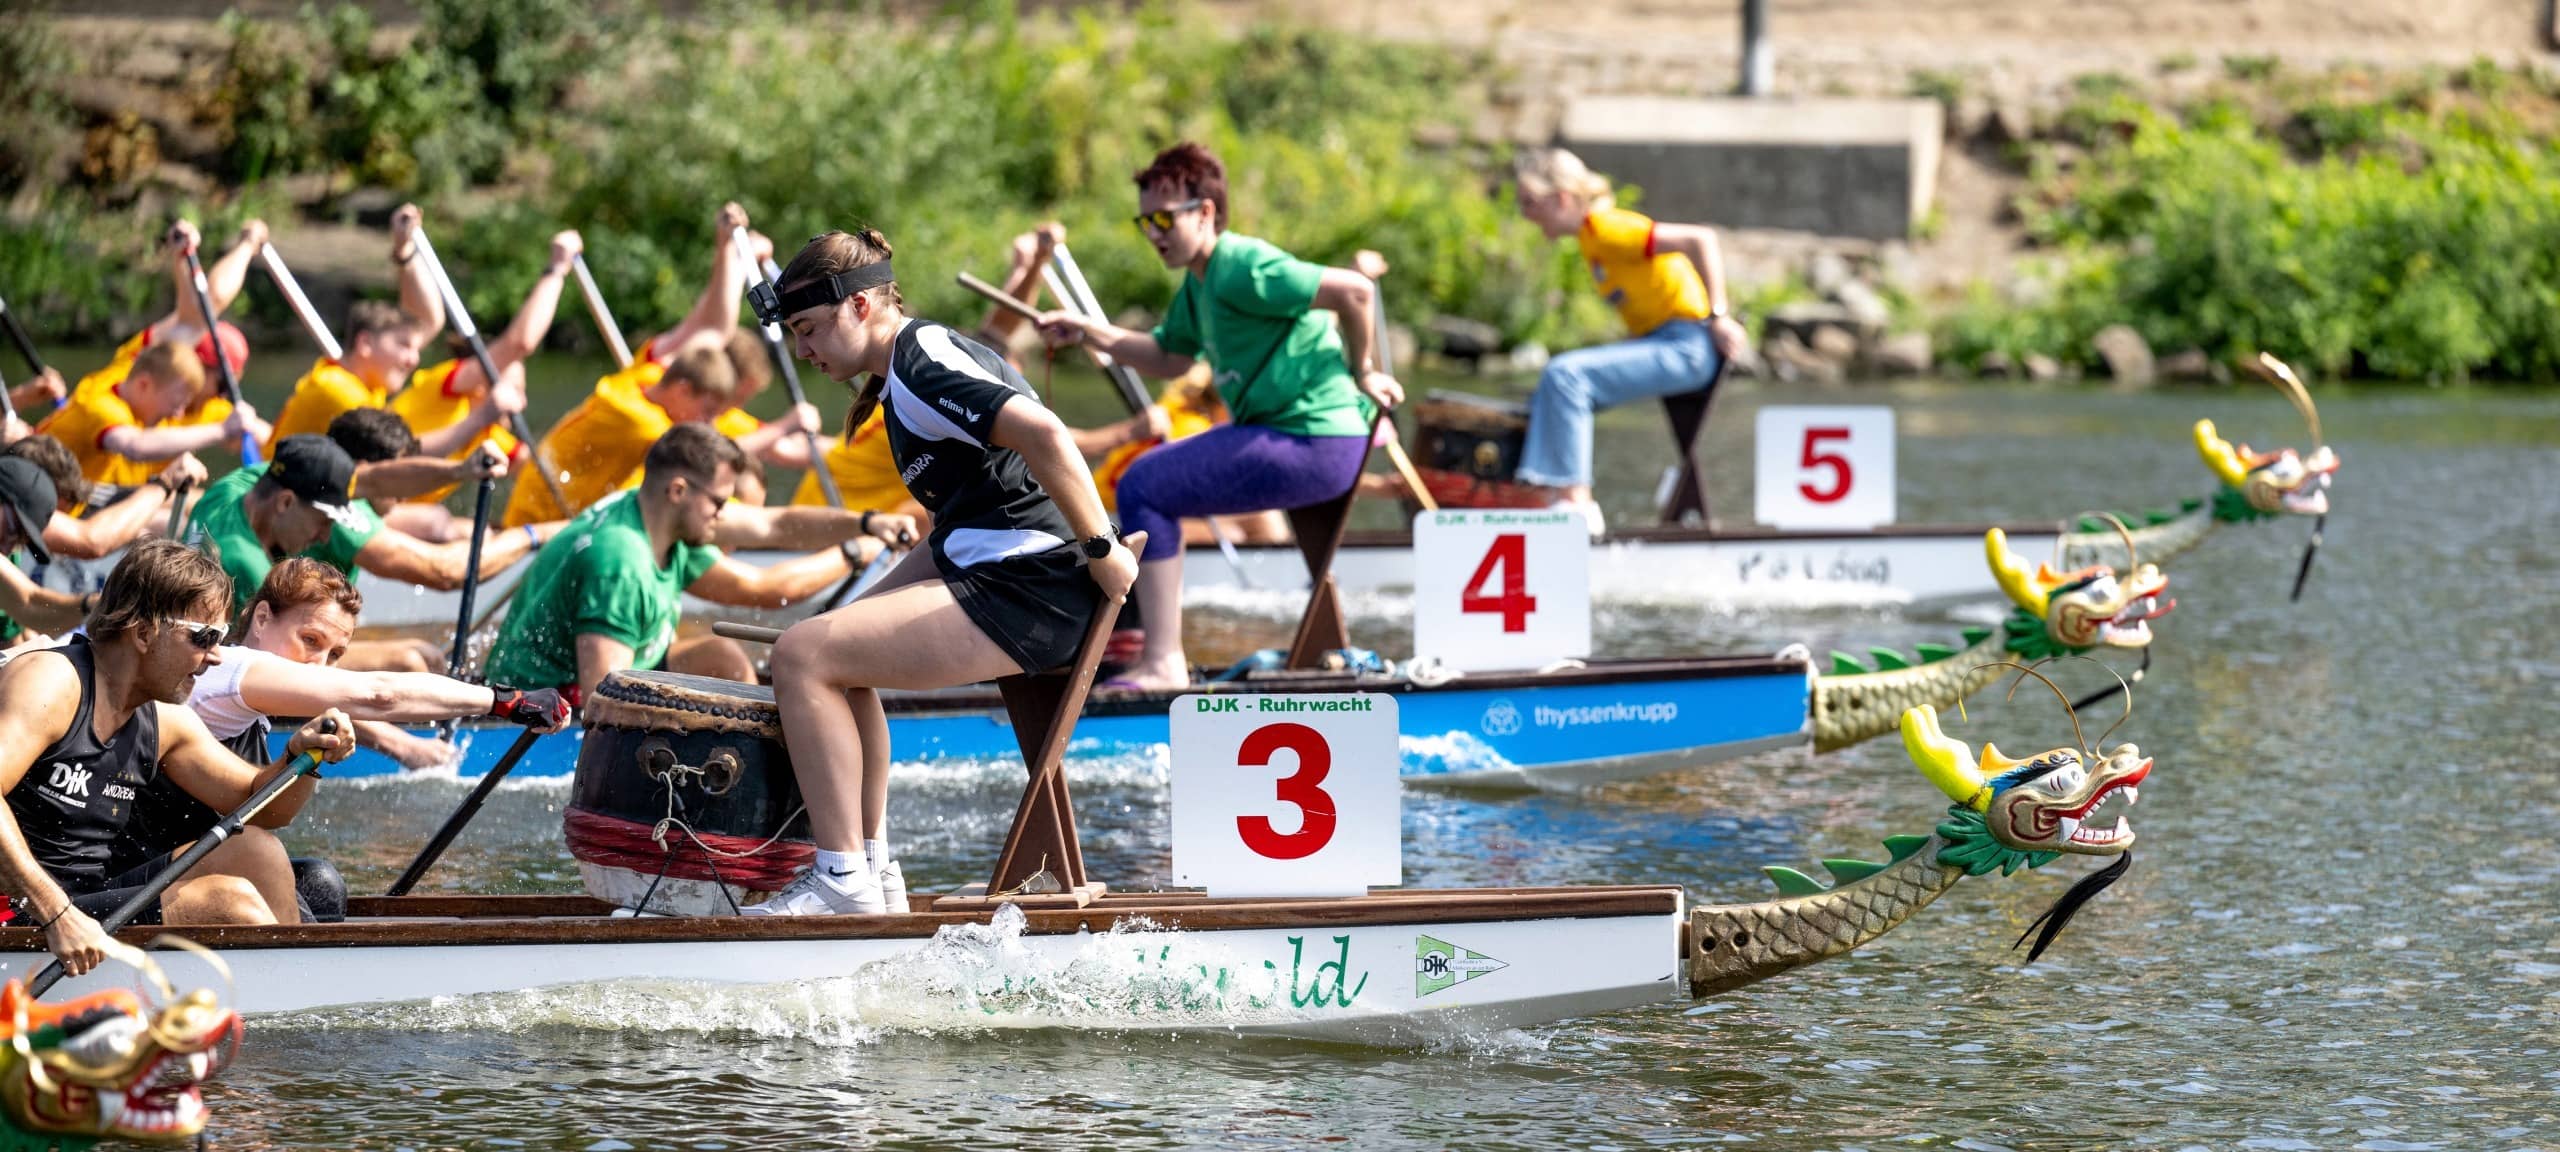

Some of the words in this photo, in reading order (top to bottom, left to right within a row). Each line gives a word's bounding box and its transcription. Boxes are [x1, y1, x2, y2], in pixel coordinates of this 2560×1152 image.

[938, 397, 964, 416] erima
[1800, 427, 1852, 503] 5
[1462, 533, 1536, 632] 4
[1197, 698, 1239, 713] DJK
[1259, 697, 1372, 712] Ruhrwacht
[1534, 702, 1679, 730] thyssenkrupp
[1236, 722, 1337, 860] 3
[1423, 955, 1449, 977] DJK
